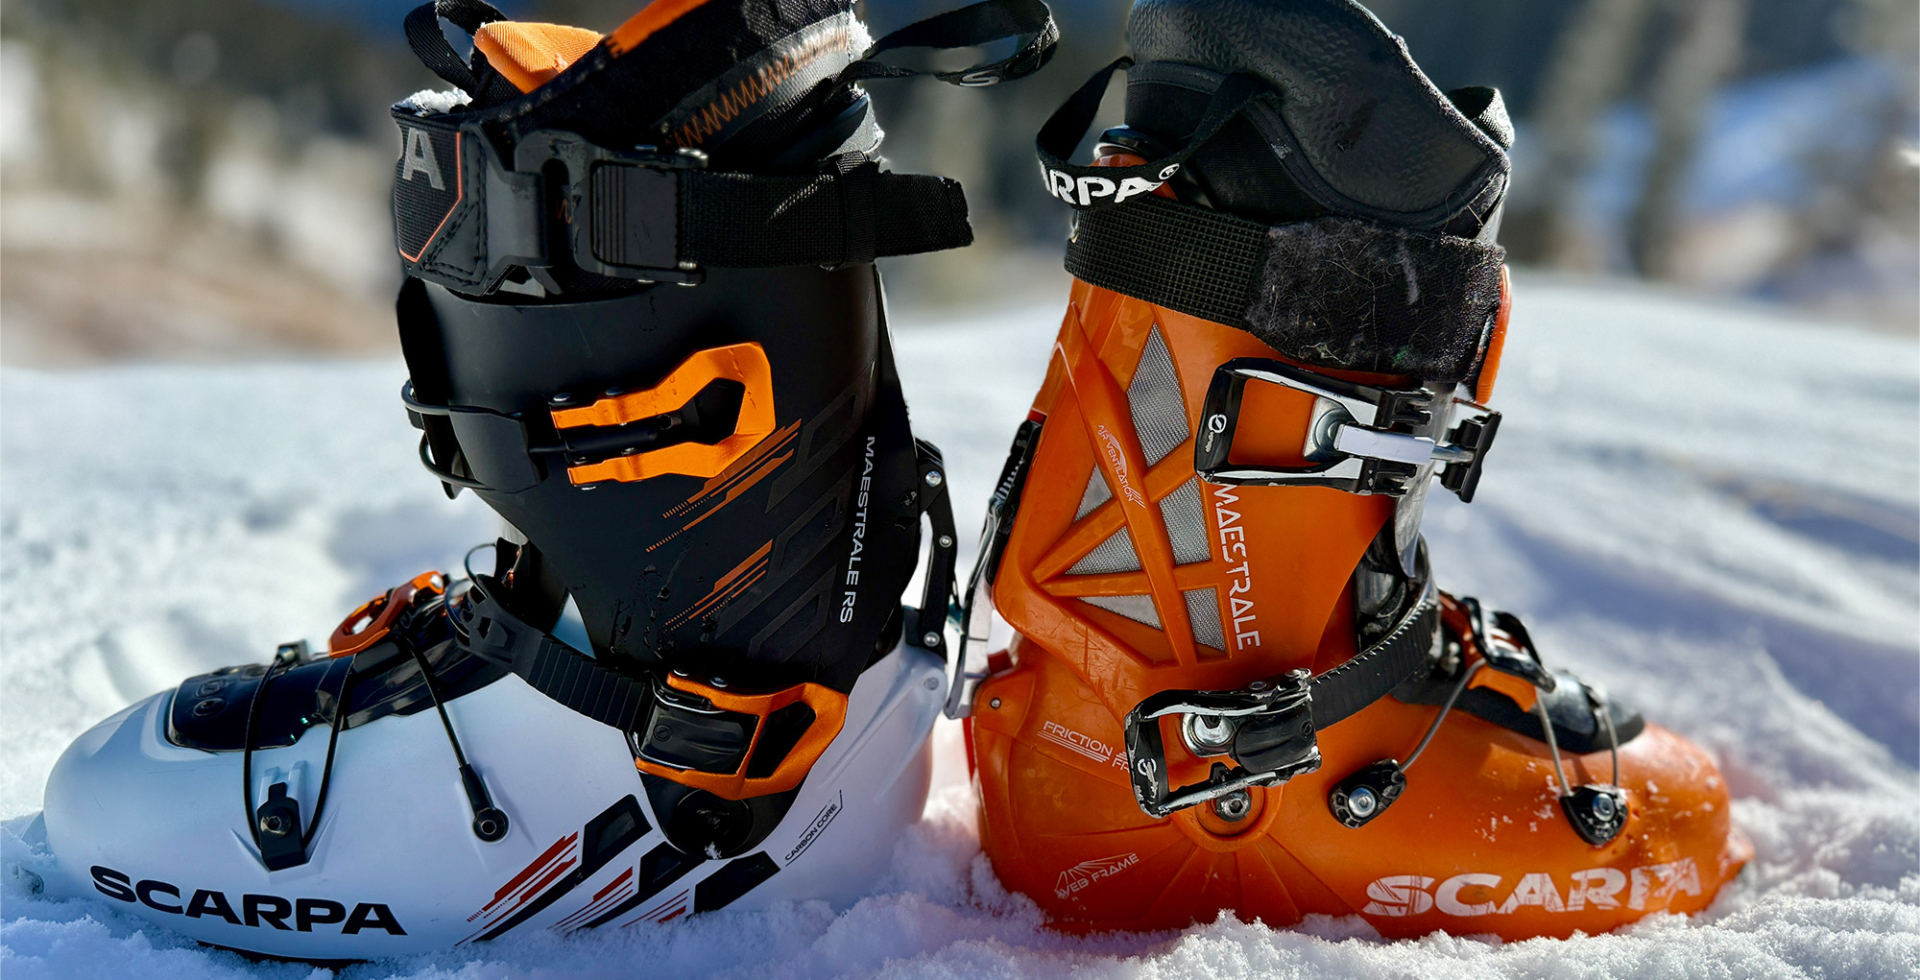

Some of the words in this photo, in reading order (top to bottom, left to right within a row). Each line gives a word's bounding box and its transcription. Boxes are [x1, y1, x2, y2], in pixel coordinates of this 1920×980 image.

[1106, 441, 1135, 502] VENTILATION
[846, 436, 876, 586] MAESTRALE
[1213, 485, 1261, 651] MAESTRALE
[839, 591, 857, 624] RS
[1043, 720, 1114, 757] FRICTION
[1112, 757, 1131, 774] FR
[784, 827, 818, 861] CARBON
[816, 803, 838, 829] CORE
[1091, 853, 1140, 883] FRAME
[89, 865, 409, 936] SCARPA
